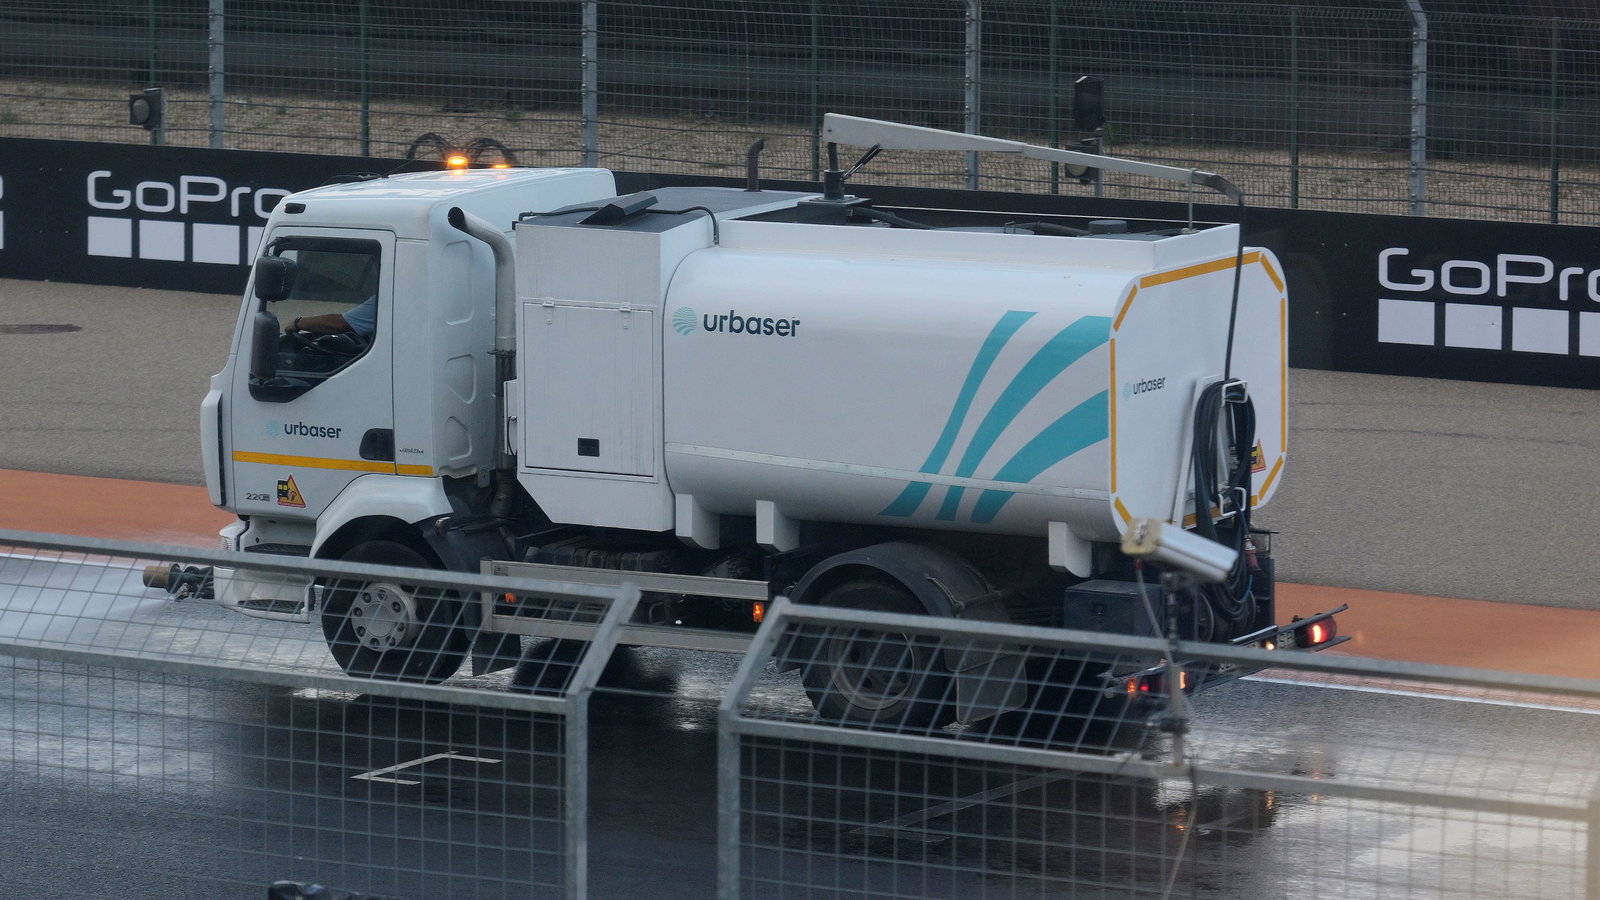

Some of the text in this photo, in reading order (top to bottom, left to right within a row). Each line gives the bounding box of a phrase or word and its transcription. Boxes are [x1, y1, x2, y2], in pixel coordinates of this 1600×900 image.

[87, 170, 293, 219] GoPro
[1378, 247, 1600, 304] GoPr
[703, 309, 800, 337] urbaser
[1133, 377, 1166, 395] urbaser
[284, 421, 342, 439] urbaser
